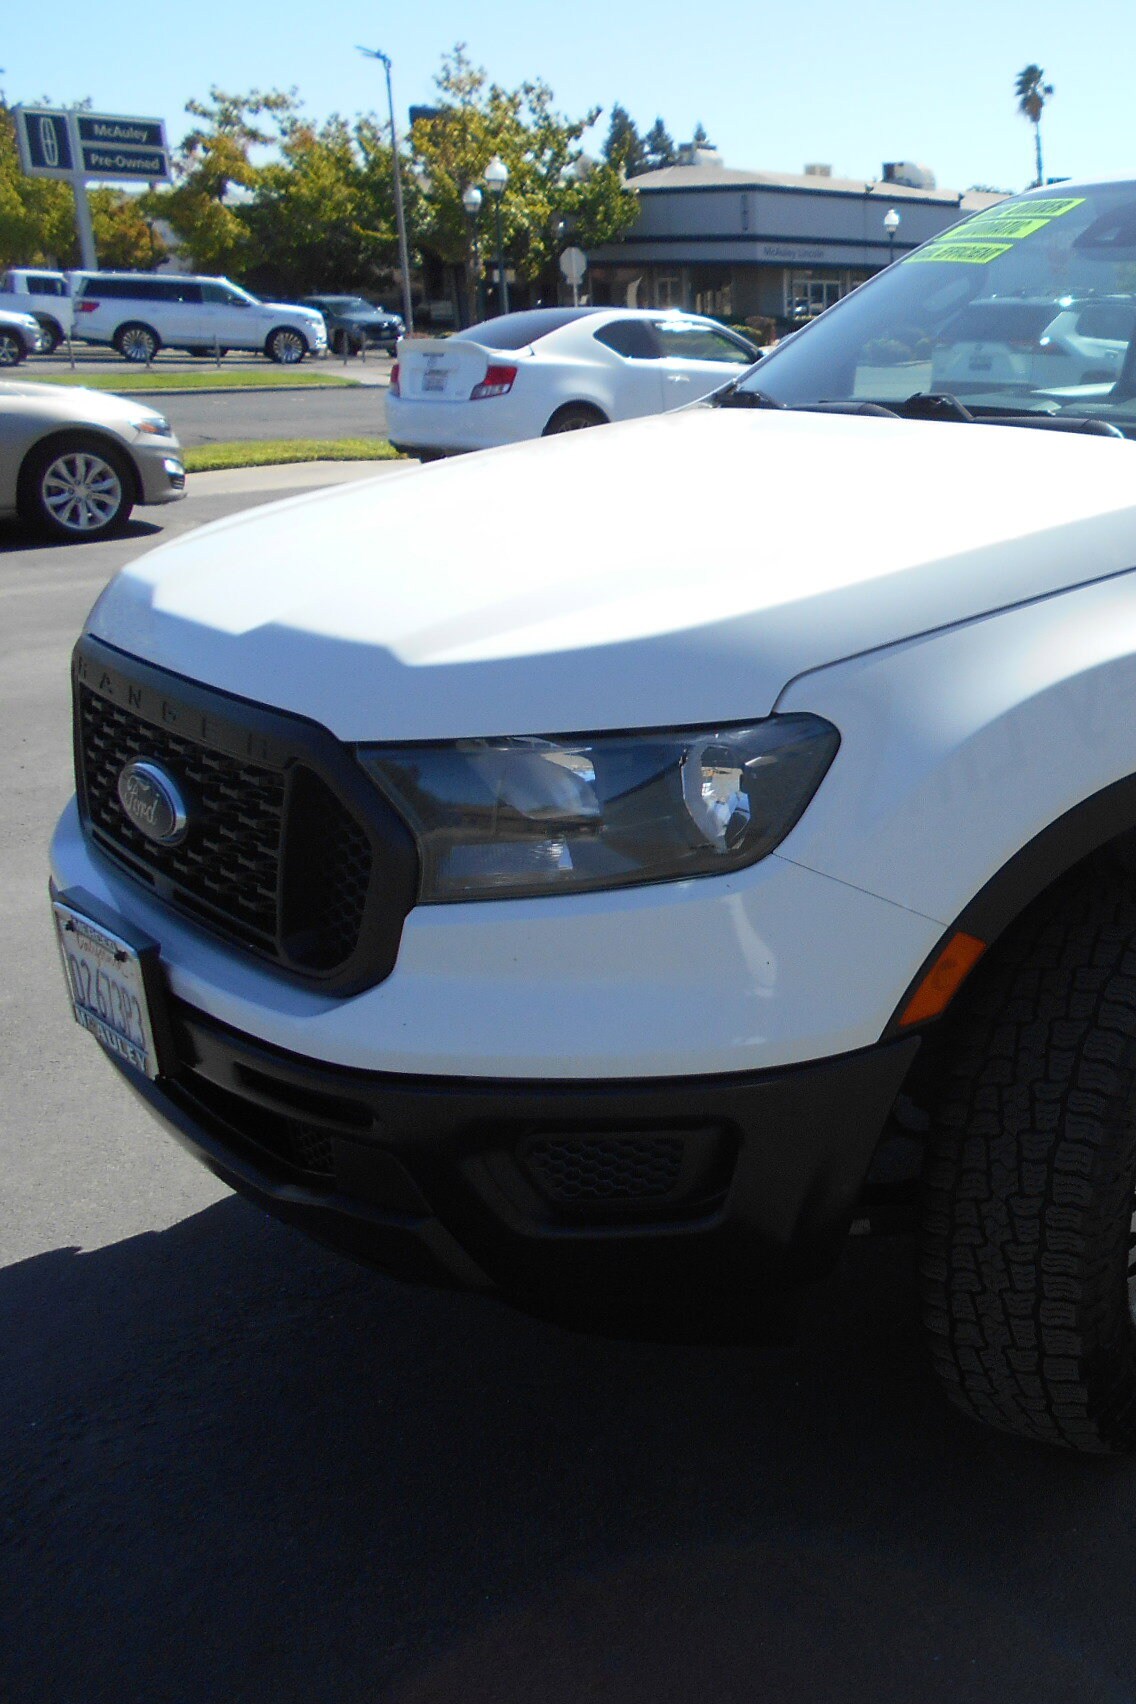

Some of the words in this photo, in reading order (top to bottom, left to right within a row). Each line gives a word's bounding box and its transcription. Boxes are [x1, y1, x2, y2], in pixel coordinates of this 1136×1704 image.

[93, 124, 148, 143] McAuley
[90, 153, 160, 171] Pre-Owned
[124, 775, 160, 826] Ford
